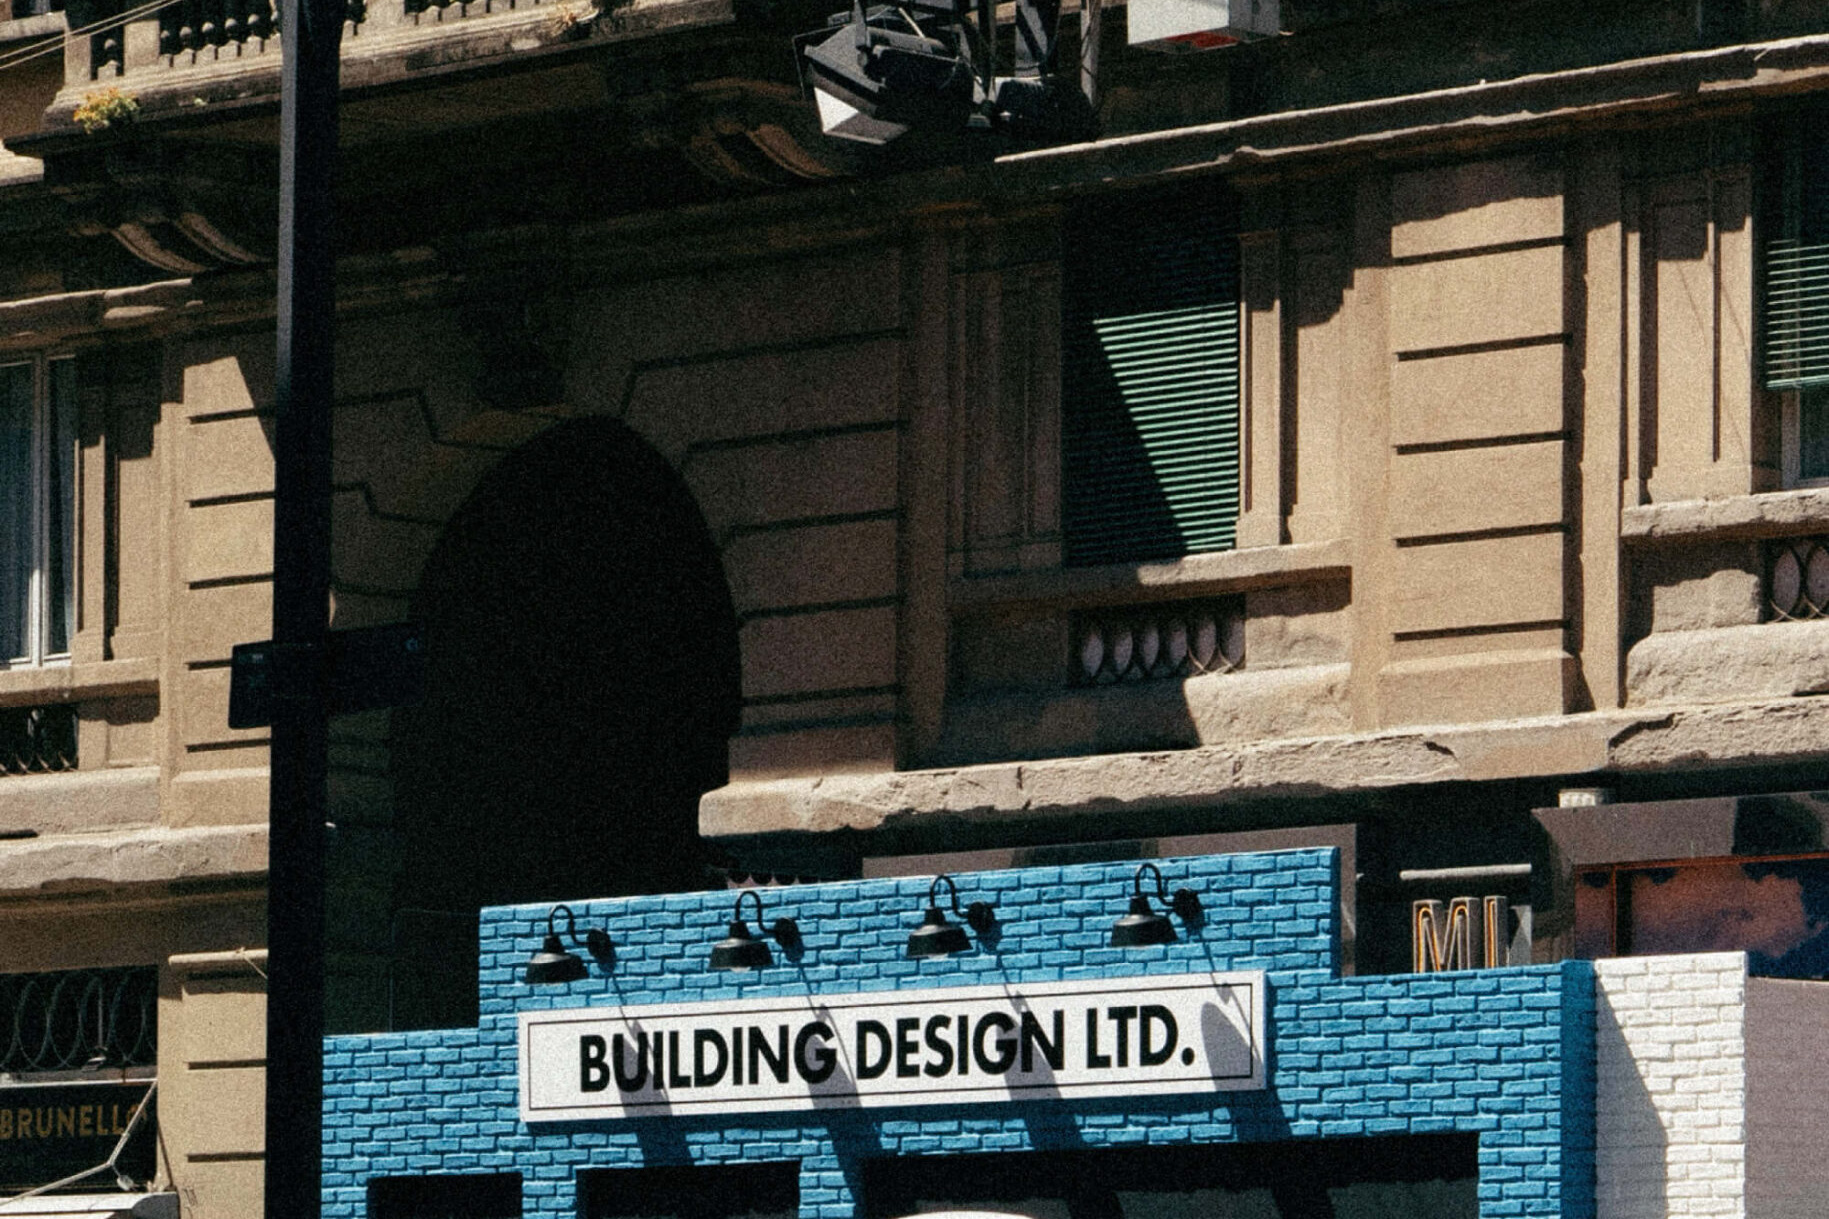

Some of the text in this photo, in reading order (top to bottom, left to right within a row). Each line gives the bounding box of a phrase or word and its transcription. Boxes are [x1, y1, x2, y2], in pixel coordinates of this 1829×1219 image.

[580, 1004, 1195, 1093] BUILDING DESIGN LTD.
